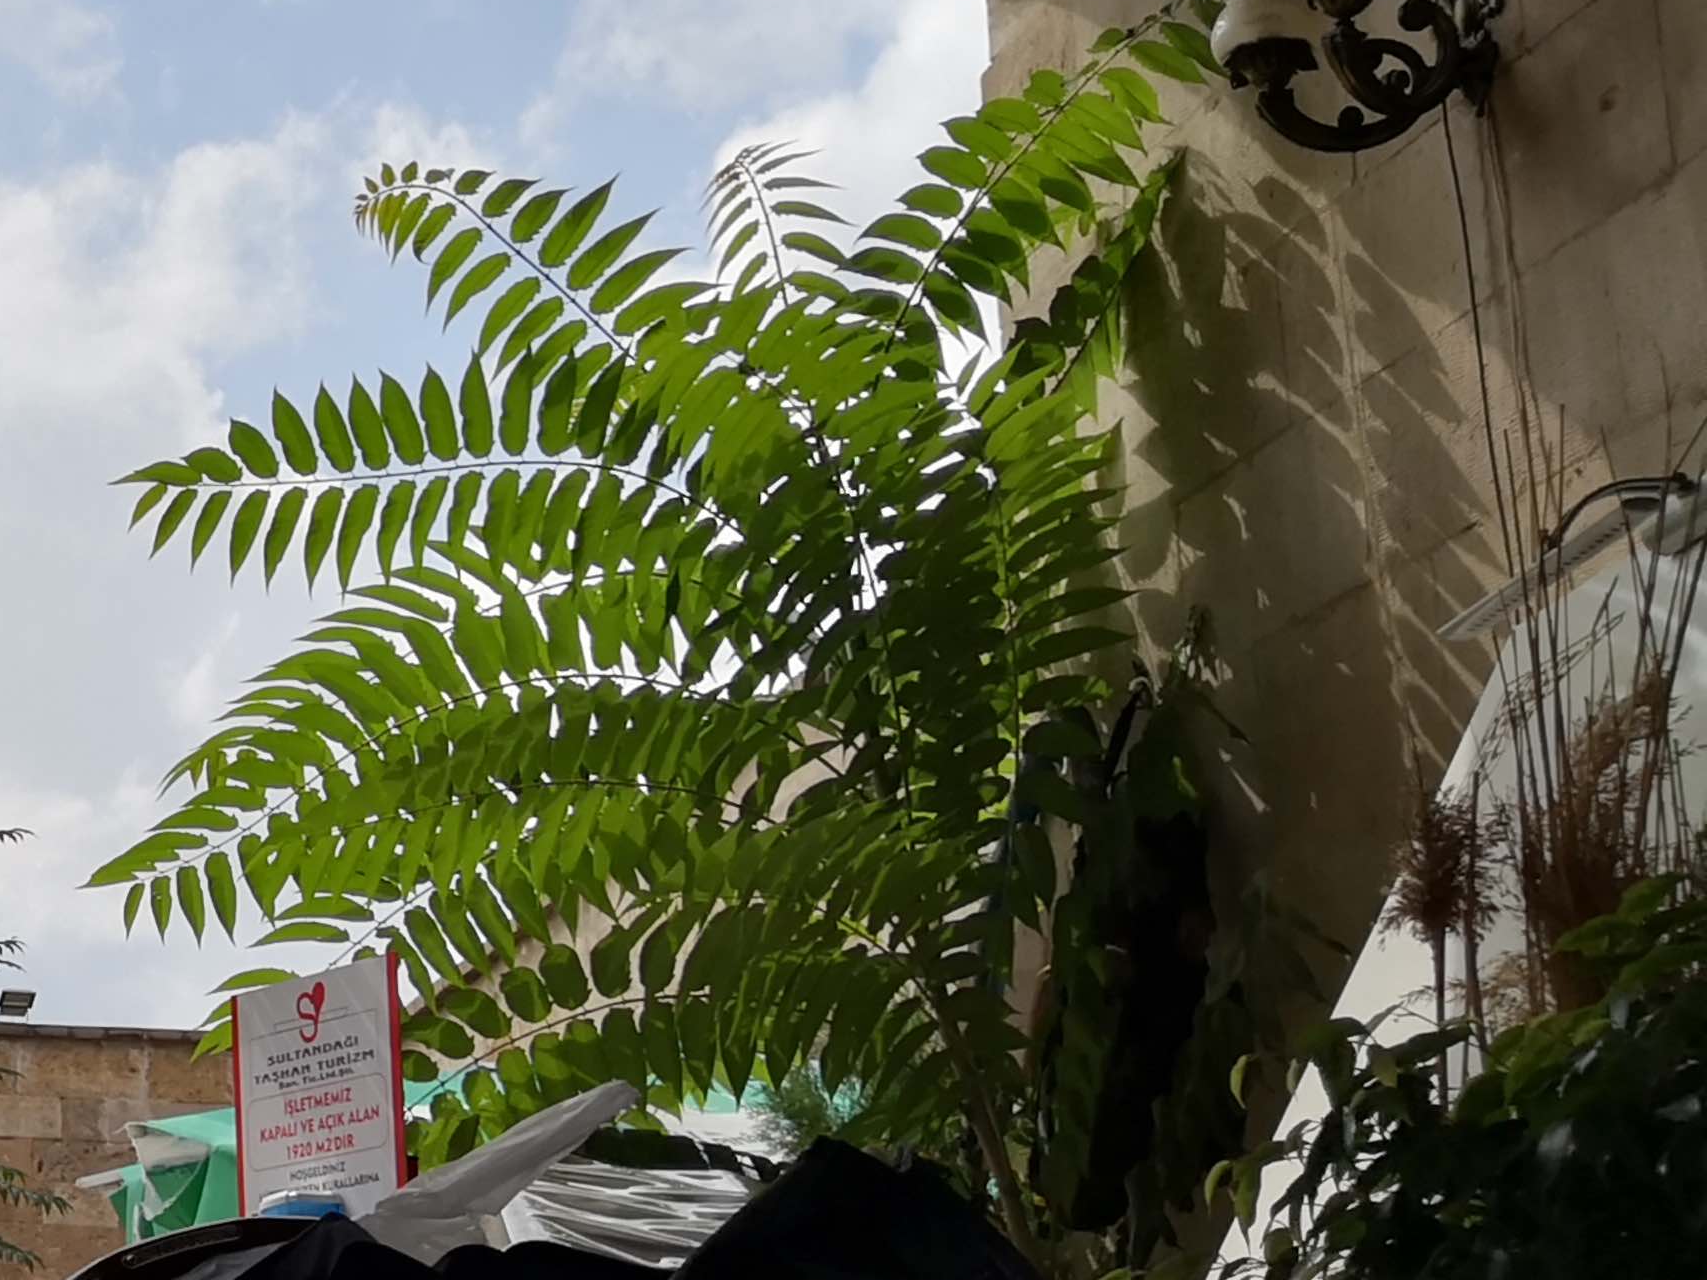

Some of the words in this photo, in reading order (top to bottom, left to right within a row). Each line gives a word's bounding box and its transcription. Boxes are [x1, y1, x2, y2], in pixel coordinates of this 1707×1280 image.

[267, 1035, 358, 1066] SULTANDAĞI
[254, 1064, 310, 1084] TAŞHAN
[317, 1049, 375, 1071] TURİZM
[284, 1087, 352, 1117] İŞLETMEMİZ
[260, 1122, 298, 1143] KAPALI
[300, 1118, 314, 1132] VE
[317, 1111, 345, 1132] AÇIK
[348, 1105, 380, 1125] ALAN
[287, 1141, 313, 1160] 1920
